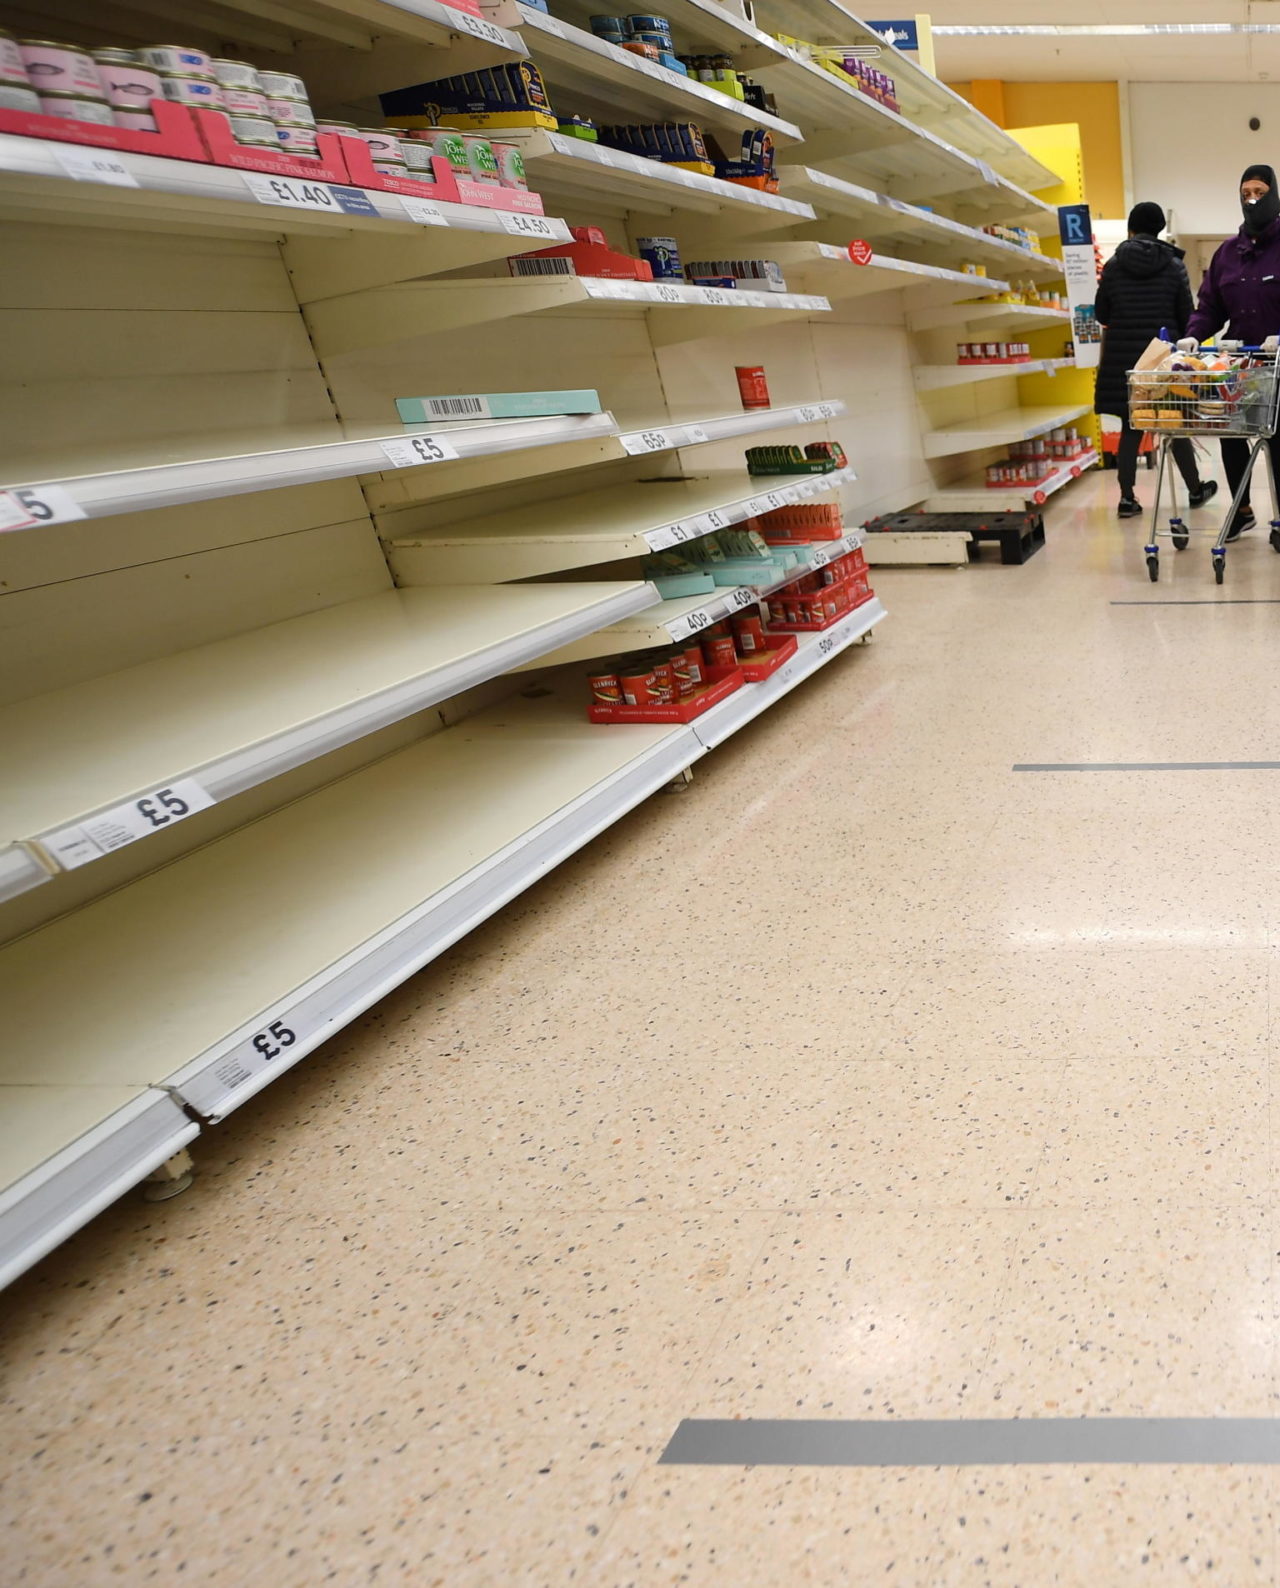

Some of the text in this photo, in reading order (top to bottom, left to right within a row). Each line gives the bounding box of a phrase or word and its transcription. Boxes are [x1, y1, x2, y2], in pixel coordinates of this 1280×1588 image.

[462, 15, 505, 43] £3.30
[270, 180, 332, 206] £1.40
[513, 216, 550, 234] £4.50
[1066, 214, 1084, 238] R
[410, 438, 445, 462] £5
[641, 433, 666, 449] 65p
[707, 512, 724, 528] £1
[670, 525, 688, 543] £1
[733, 588, 752, 606] 40p
[687, 612, 710, 631] 40p
[136, 788, 190, 827] £5
[252, 1020, 296, 1060] £5
